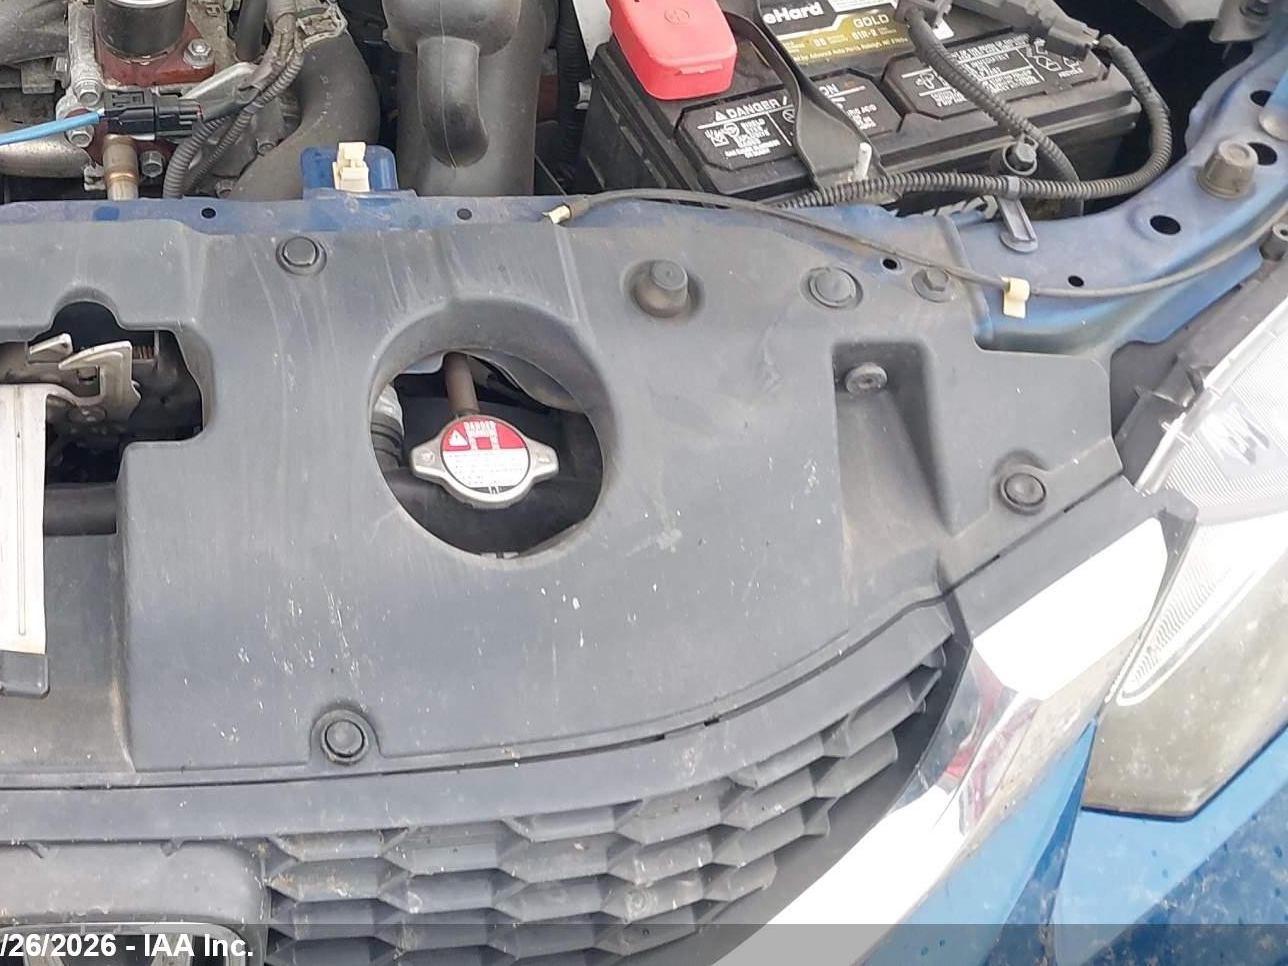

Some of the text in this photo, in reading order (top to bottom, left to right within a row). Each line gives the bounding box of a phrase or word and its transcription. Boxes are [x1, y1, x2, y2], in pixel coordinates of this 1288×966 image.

[762, 1, 824, 24] eHard
[853, 14, 890, 29] GOLD
[725, 98, 781, 119] DANGER
